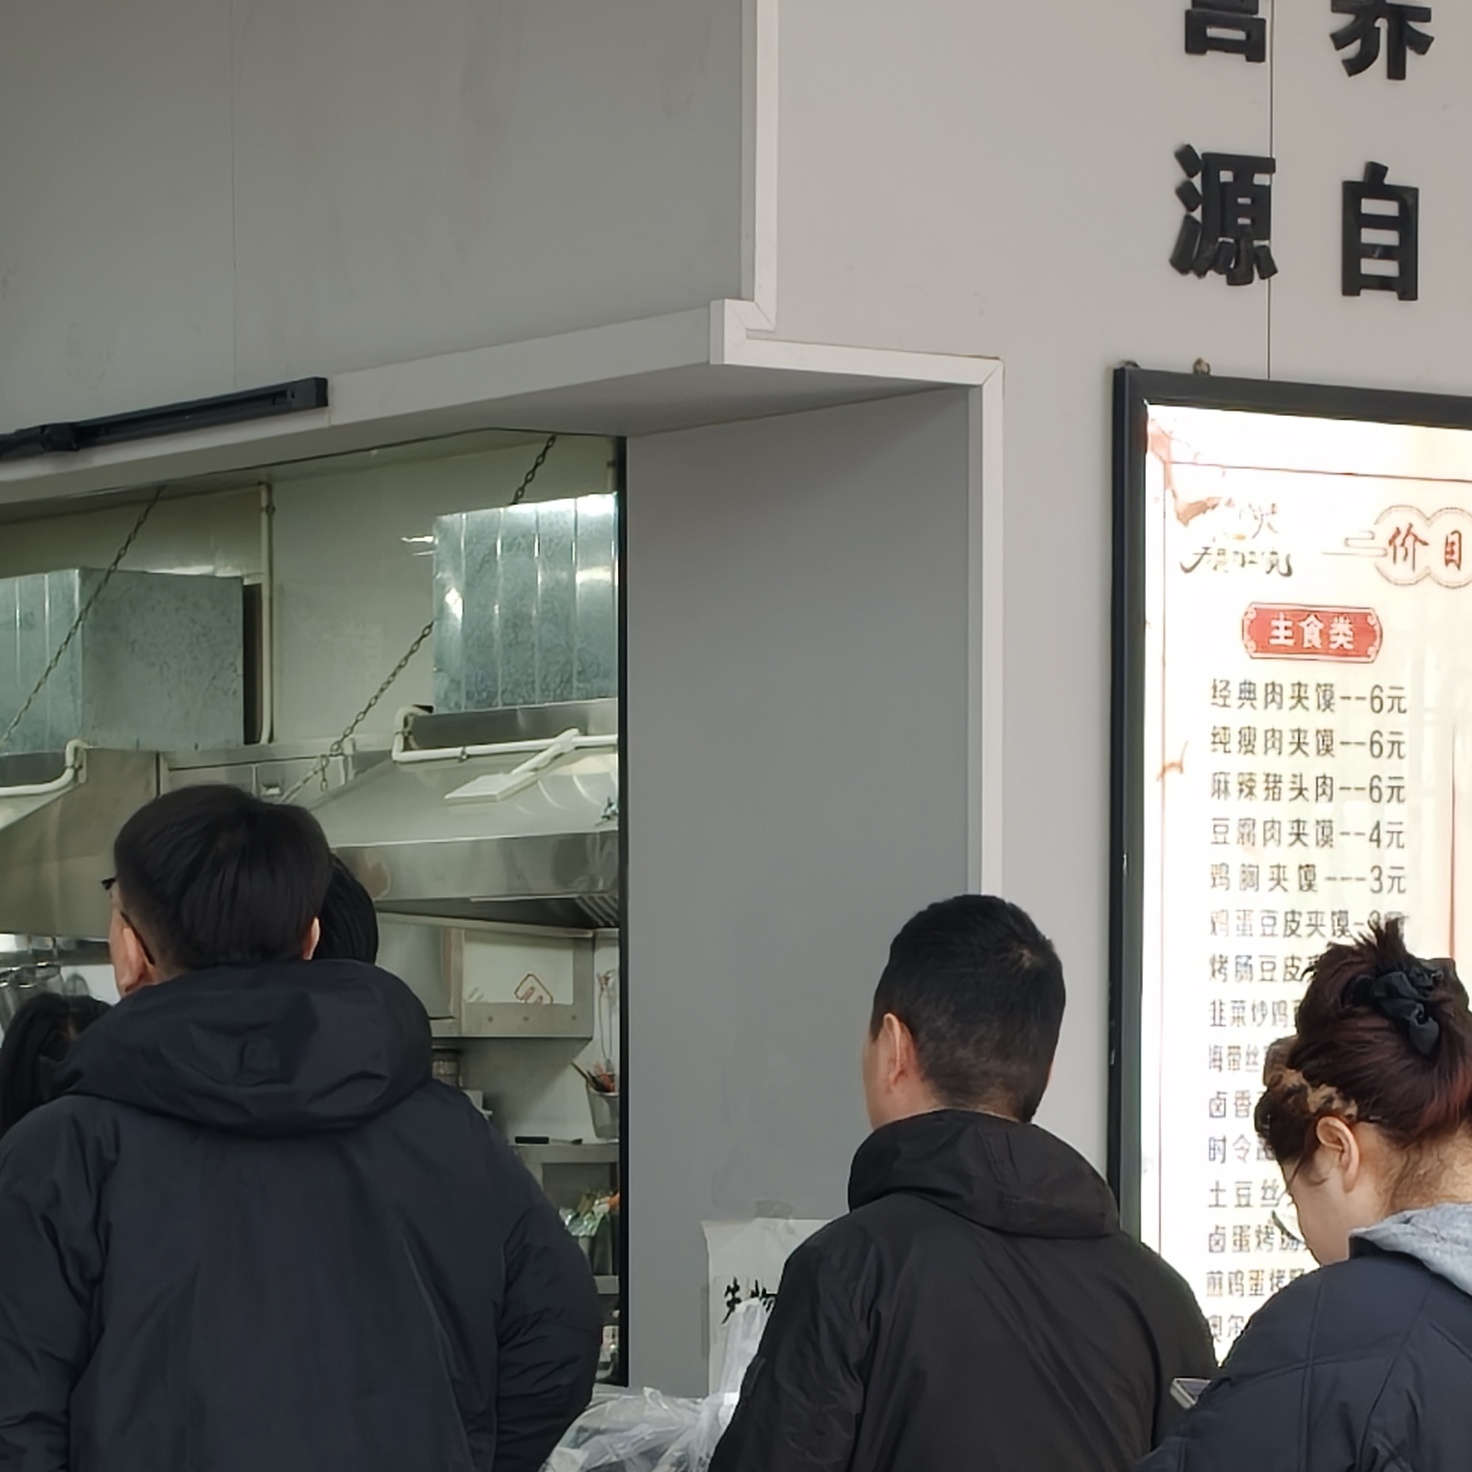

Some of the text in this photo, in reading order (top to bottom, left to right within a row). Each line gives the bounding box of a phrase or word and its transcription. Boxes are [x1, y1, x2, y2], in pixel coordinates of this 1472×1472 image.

[1268, 612, 1355, 650] 主食类
[1209, 998, 1301, 1028] 韭菜炒鸡
[1208, 1179, 1292, 1208] 土豆丝
